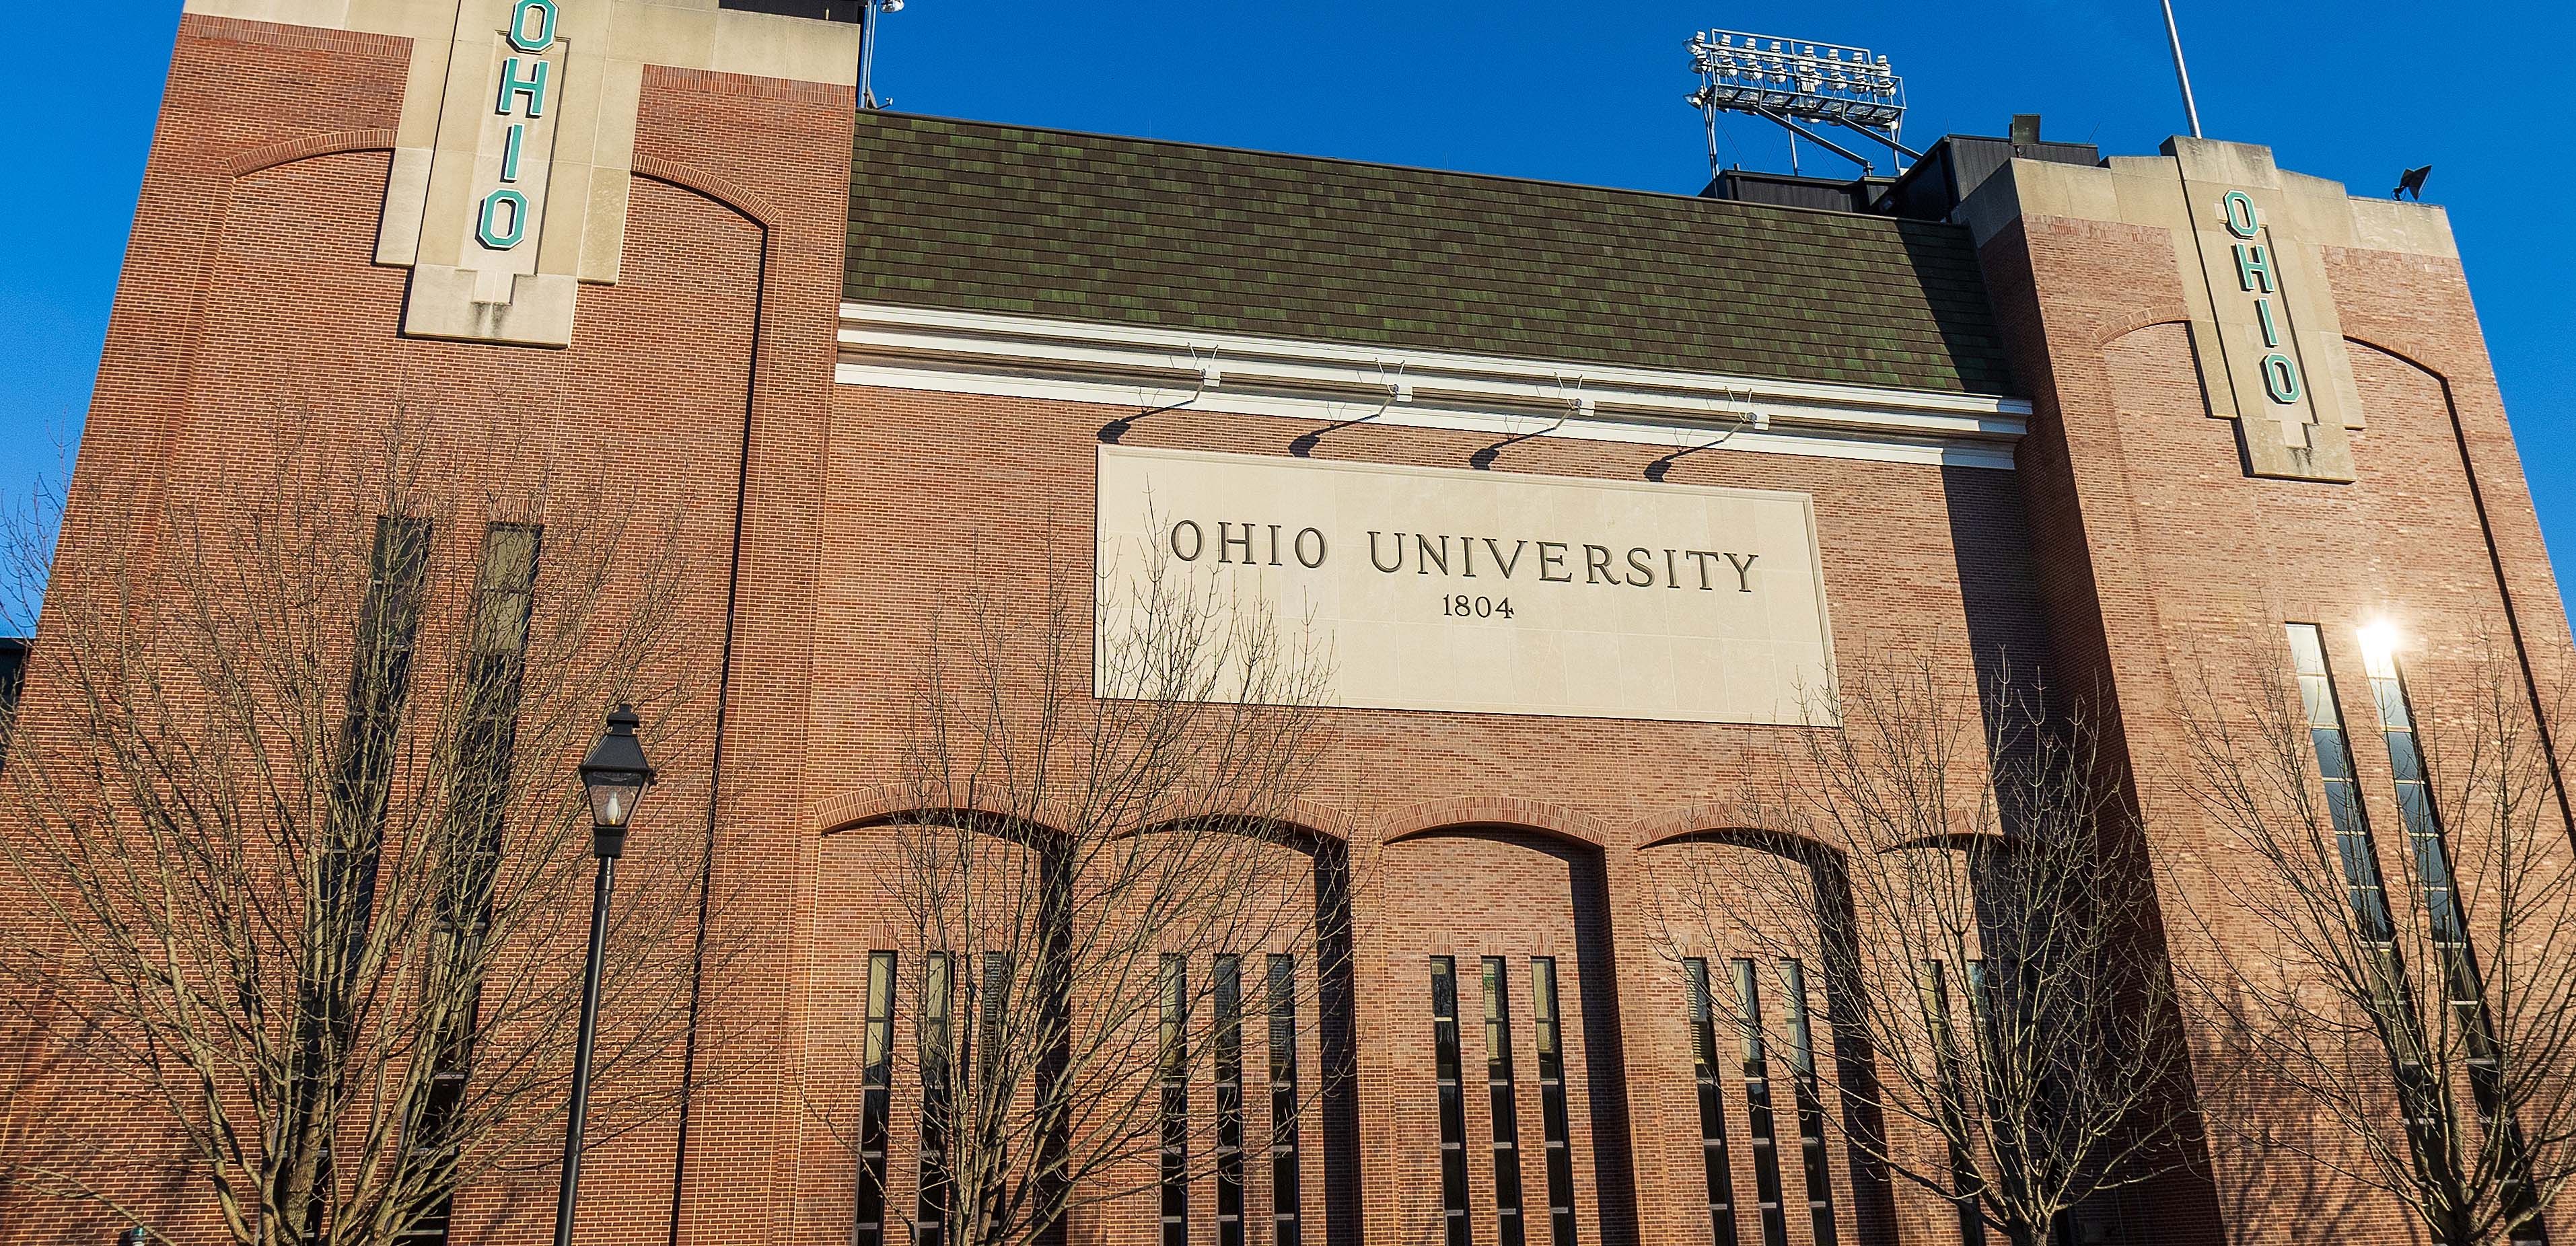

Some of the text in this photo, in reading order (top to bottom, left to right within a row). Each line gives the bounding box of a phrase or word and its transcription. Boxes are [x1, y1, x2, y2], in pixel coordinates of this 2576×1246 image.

[478, 0, 559, 249] OHIO
[2223, 190, 2301, 404] OHIO
[1171, 519, 1759, 593] OHIO UNIVERSITY
[1443, 593, 1515, 619] 1804
